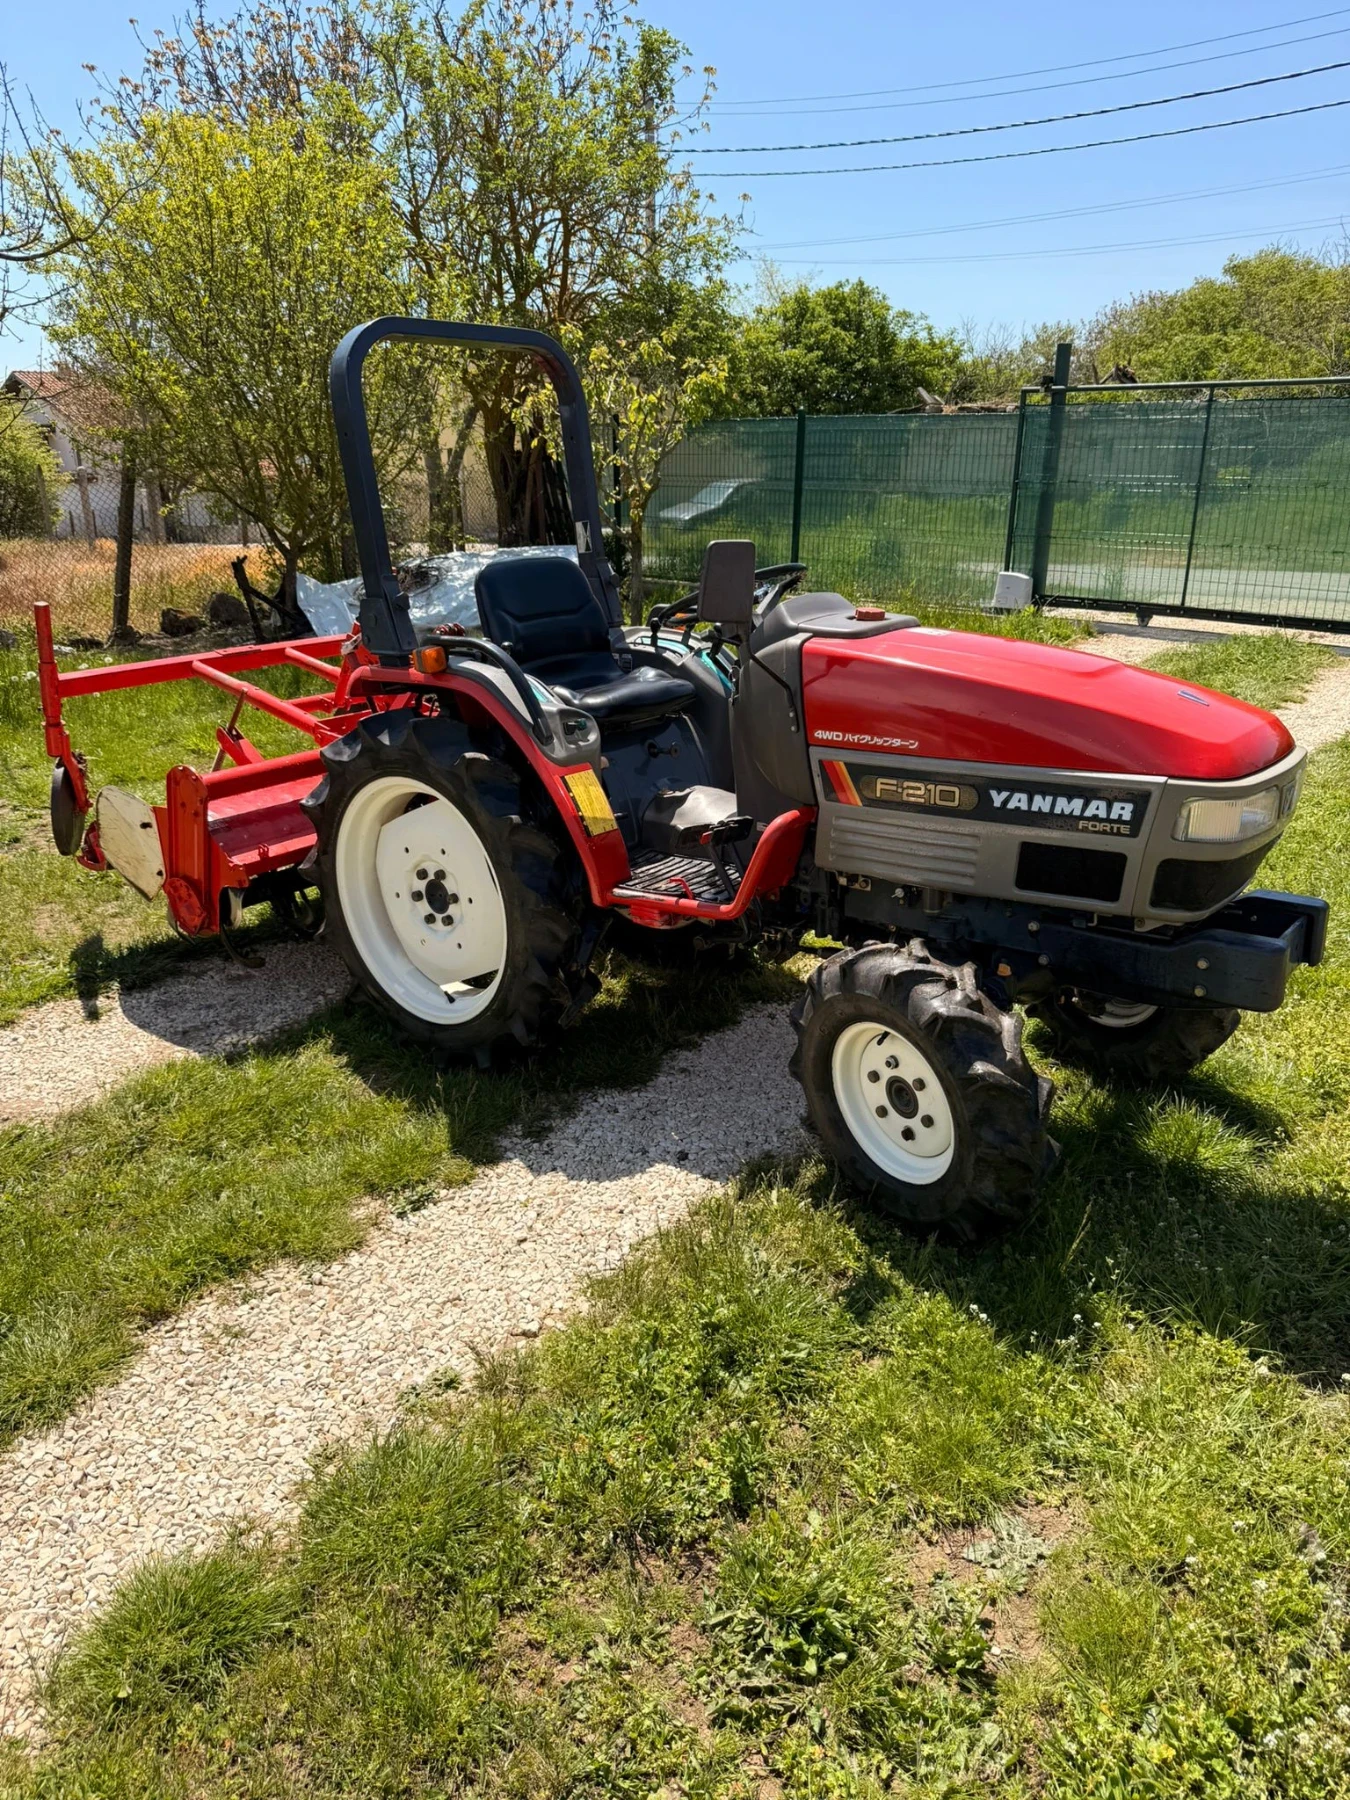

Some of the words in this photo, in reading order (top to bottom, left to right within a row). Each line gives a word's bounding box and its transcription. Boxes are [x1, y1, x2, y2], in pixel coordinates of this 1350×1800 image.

[814, 730, 842, 741] 4WD
[989, 789, 1134, 821] YANMAR
[1078, 821, 1131, 835] FORTE
